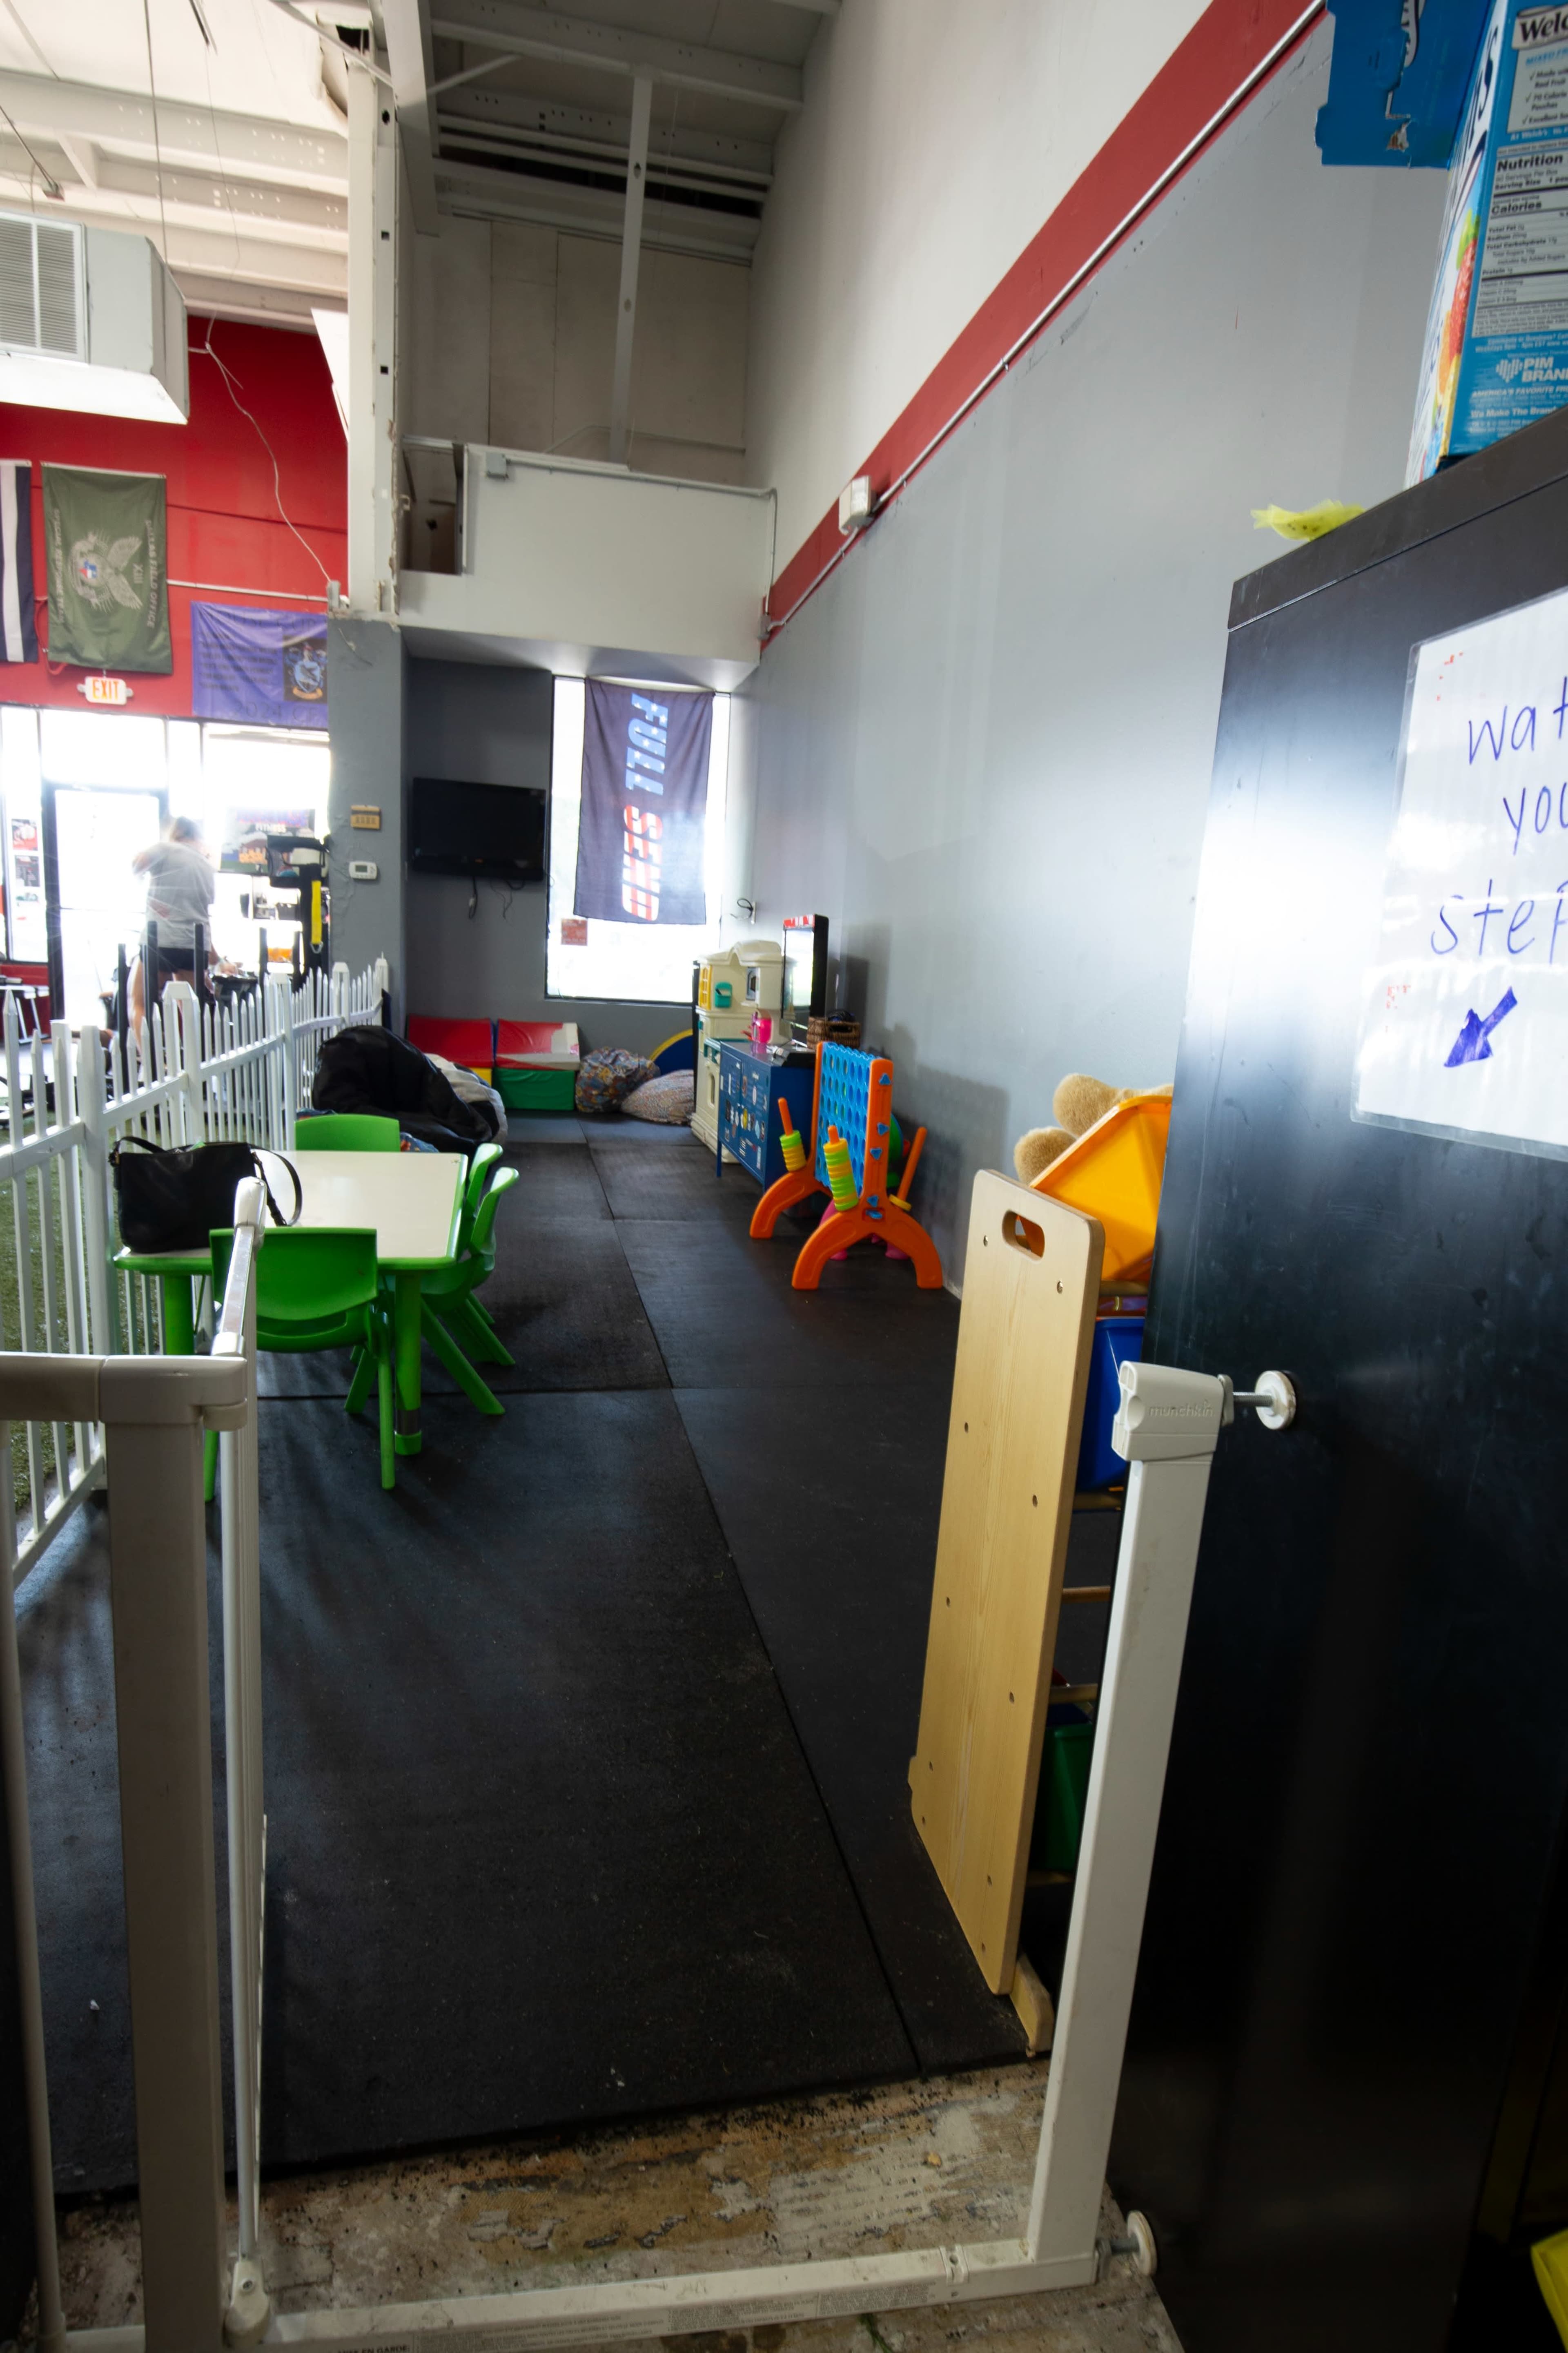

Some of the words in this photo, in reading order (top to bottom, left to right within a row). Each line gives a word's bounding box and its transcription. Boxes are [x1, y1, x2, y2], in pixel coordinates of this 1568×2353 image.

[1497, 154, 1564, 172] Nutrition
[1494, 181, 1523, 190] Serving
[1491, 201, 1542, 214] Calories
[1503, 238, 1547, 248] Carbohydrate
[1482, 267, 1506, 276] Protein
[1523, 356, 1554, 369] PIM
[1486, 408, 1510, 417] Make
[1512, 407, 1528, 416] The
[149, 559, 158, 589] FIELD
[146, 591, 158, 628] OFFICE
[92, 678, 119, 701] EXIT
[626, 693, 668, 795] FULL
[622, 805, 662, 921] SEND
[1149, 1400, 1214, 1417] munchkin
